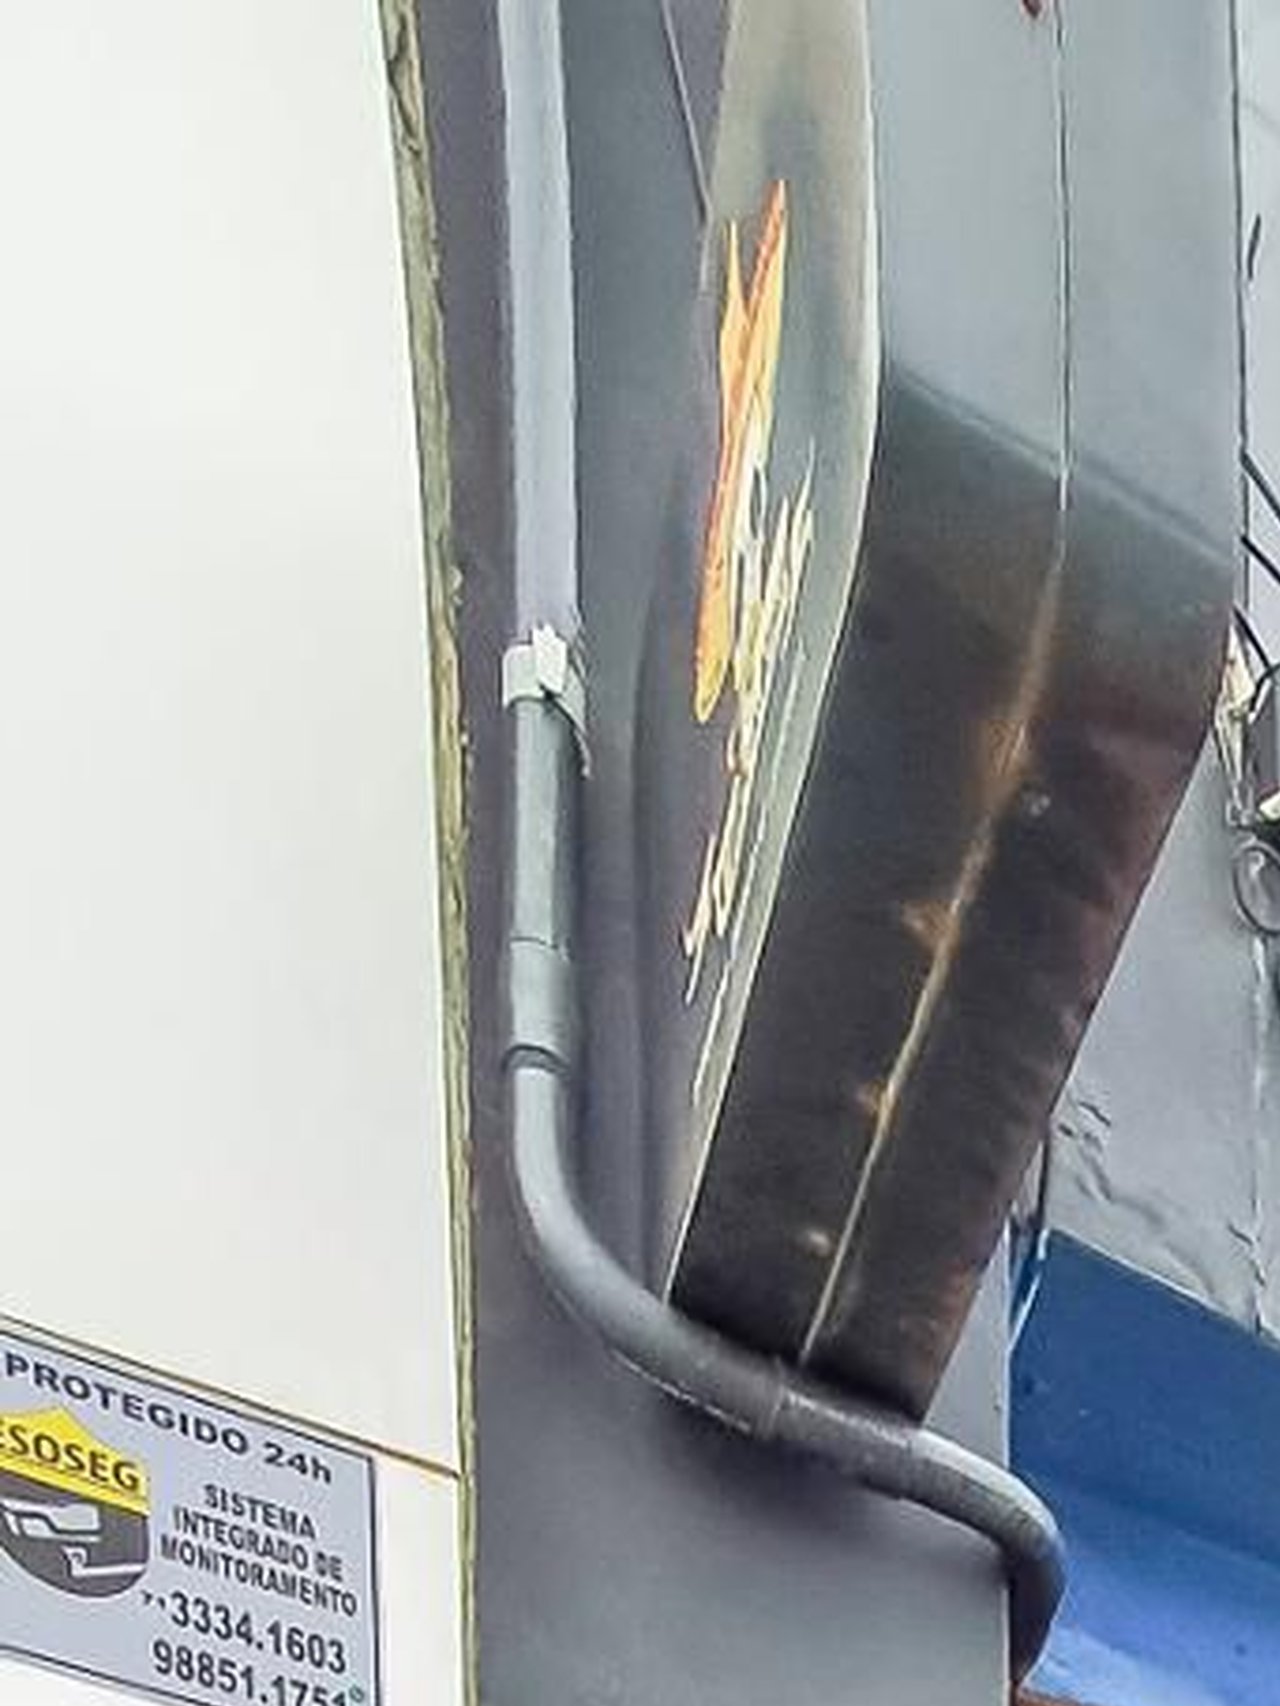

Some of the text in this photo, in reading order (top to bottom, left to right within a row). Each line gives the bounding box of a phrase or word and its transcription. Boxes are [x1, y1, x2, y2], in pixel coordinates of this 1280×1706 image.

[4, 1351, 334, 1486] PROTEGIDO 24h
[172, 1505, 344, 1582] INTEGRADO DE
[203, 1484, 317, 1540] SISTEMA
[160, 1534, 358, 1617] MONITORAMENTO
